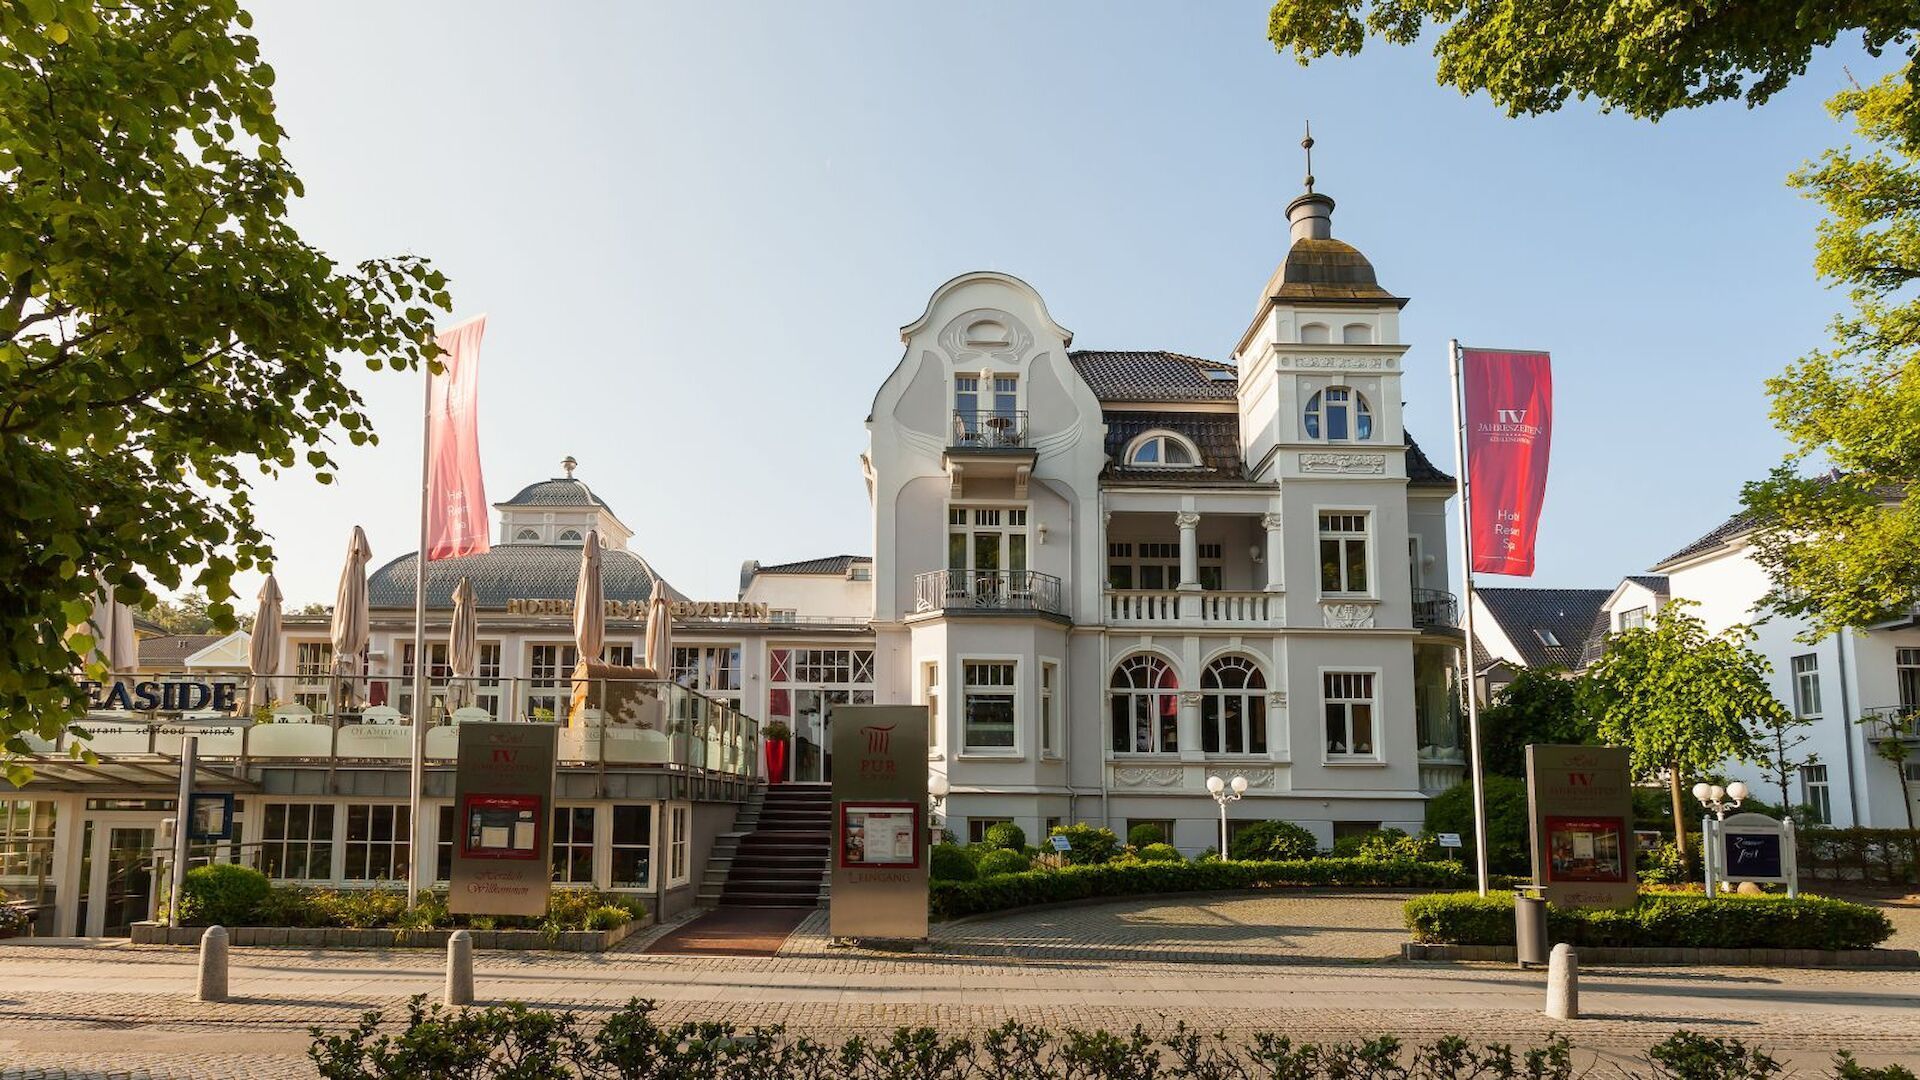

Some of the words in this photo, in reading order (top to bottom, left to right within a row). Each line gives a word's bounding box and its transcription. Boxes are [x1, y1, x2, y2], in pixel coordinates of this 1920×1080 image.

[1497, 409, 1527, 424] IV
[508, 599, 572, 616] HOTEL
[624, 600, 767, 619] JAESZEITEN
[68, 680, 238, 711] EASIDE
